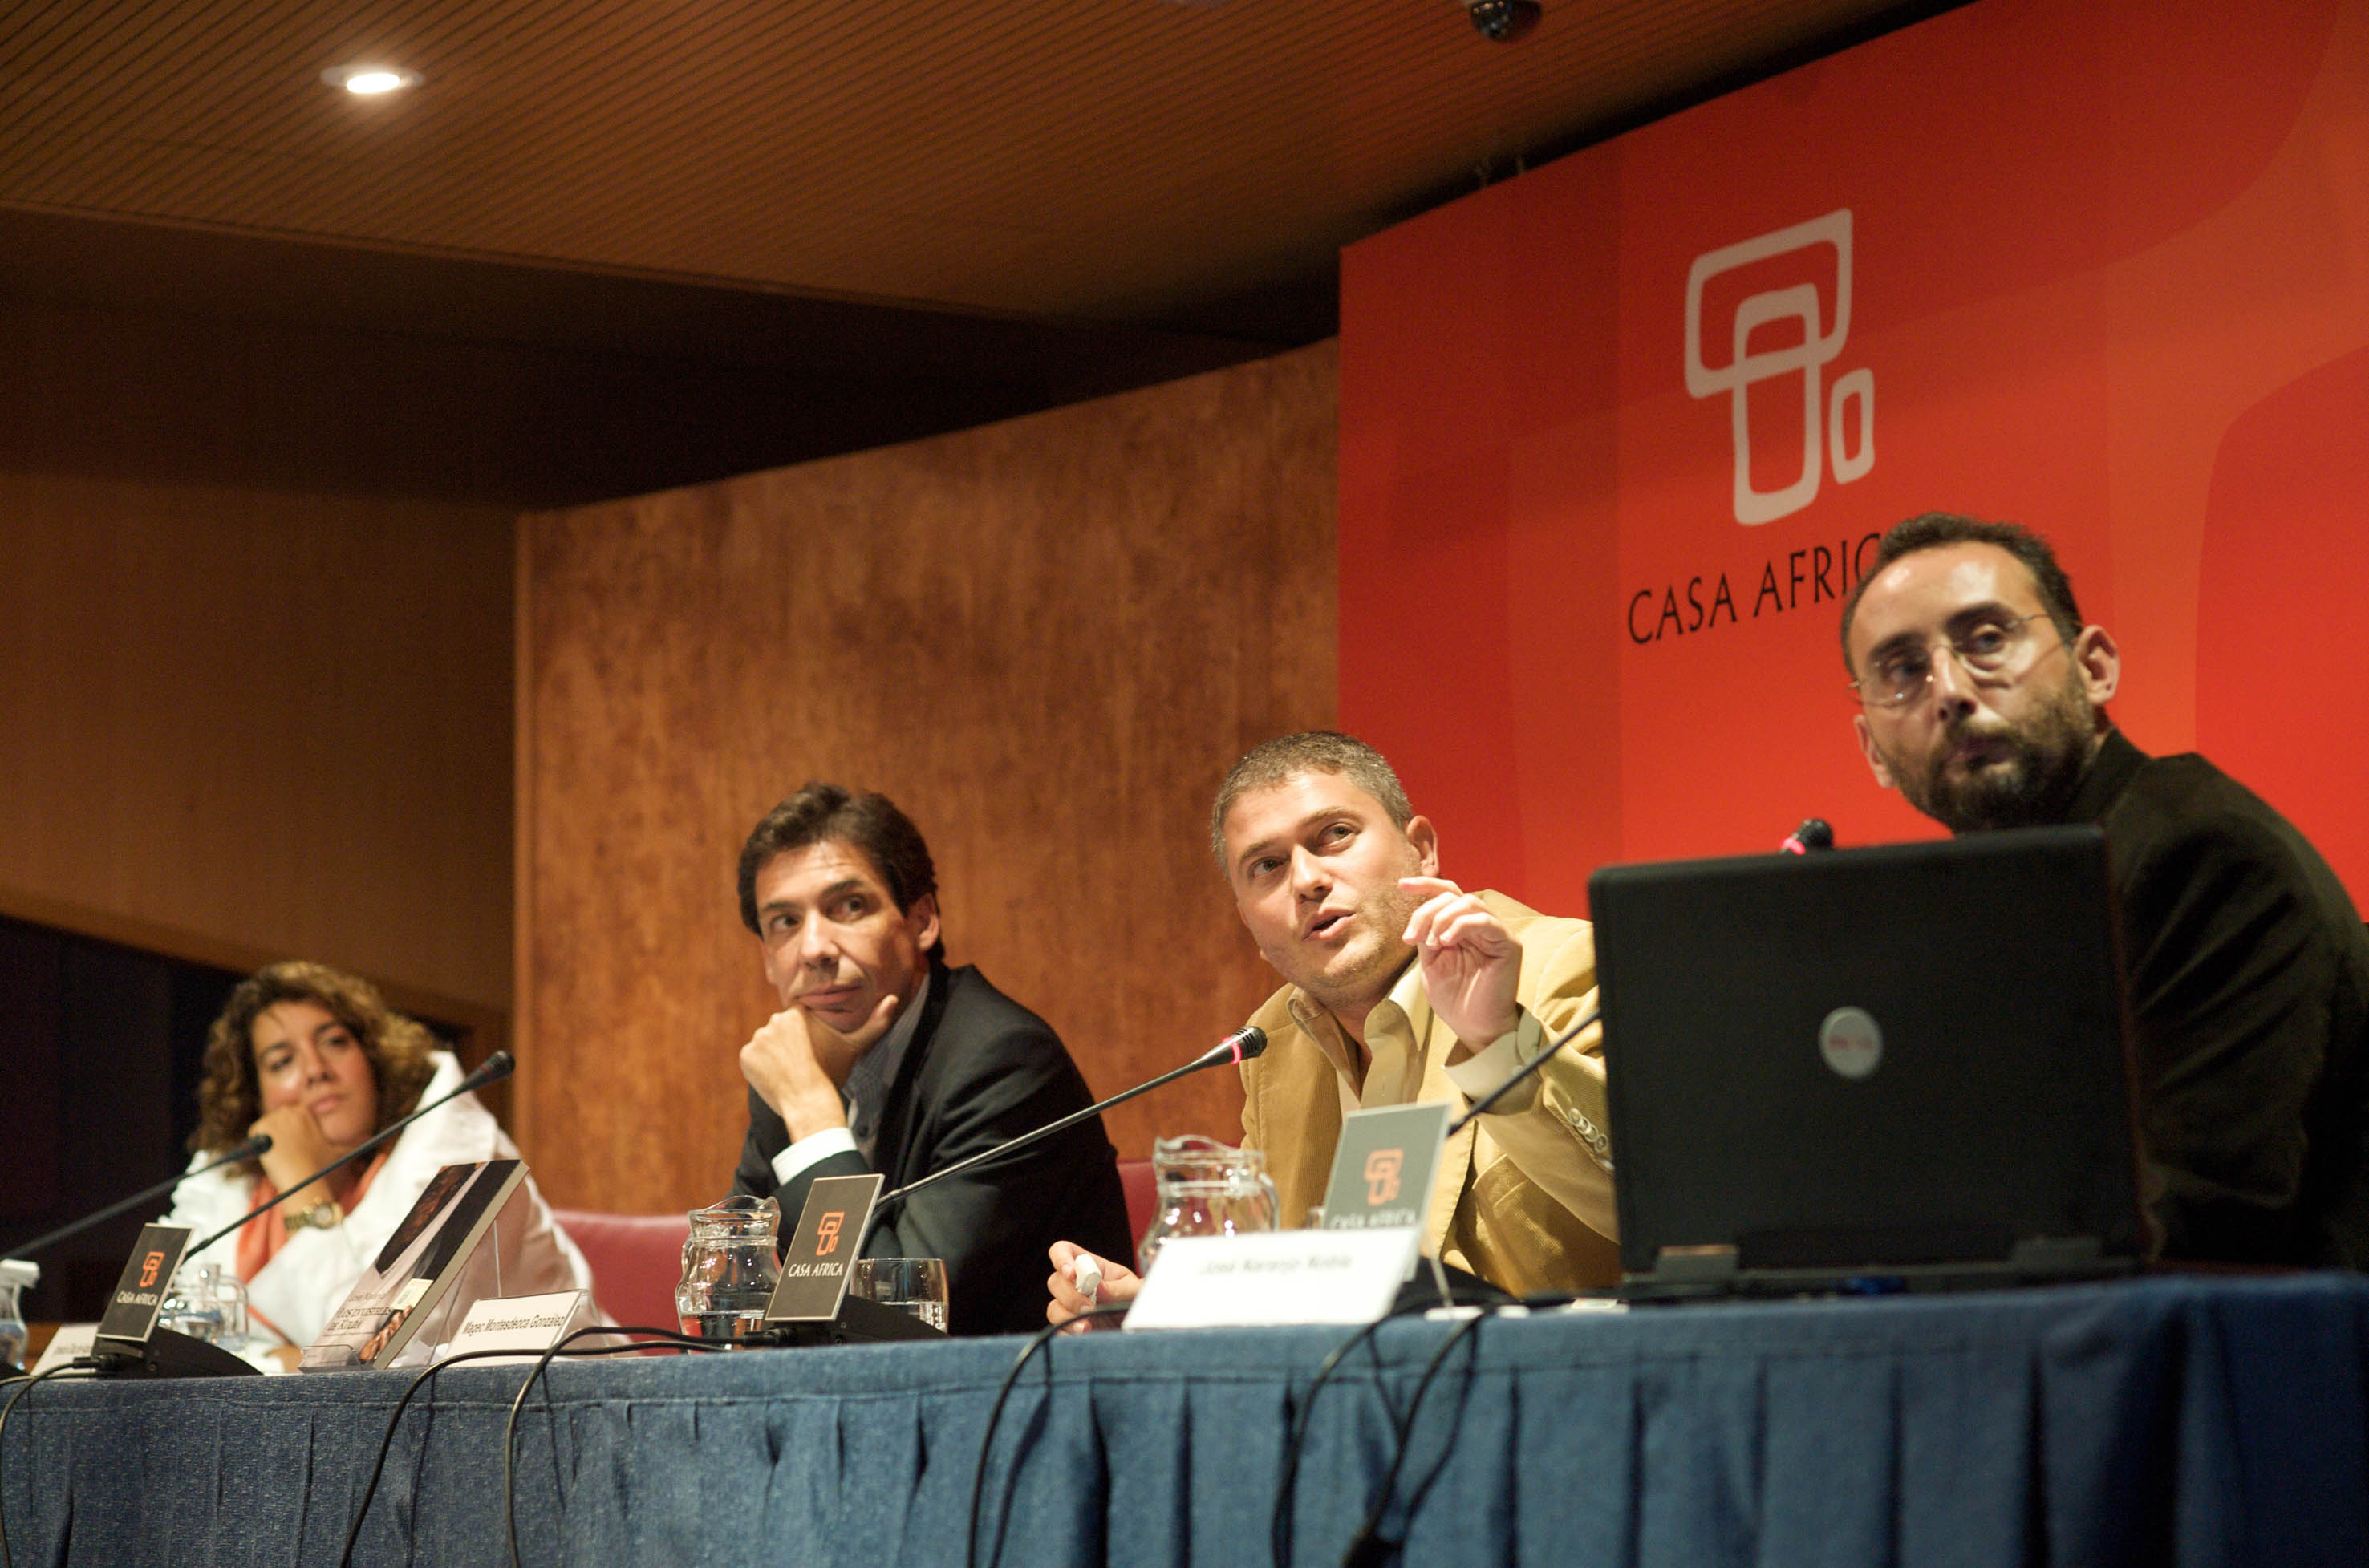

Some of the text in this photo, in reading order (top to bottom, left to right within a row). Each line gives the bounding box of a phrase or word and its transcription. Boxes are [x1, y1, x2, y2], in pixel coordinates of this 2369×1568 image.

[1628, 533, 1881, 644] CASA AFRIC
[788, 1262, 843, 1277] CASA AFRICA
[116, 1290, 160, 1306] CASA AFRICA
